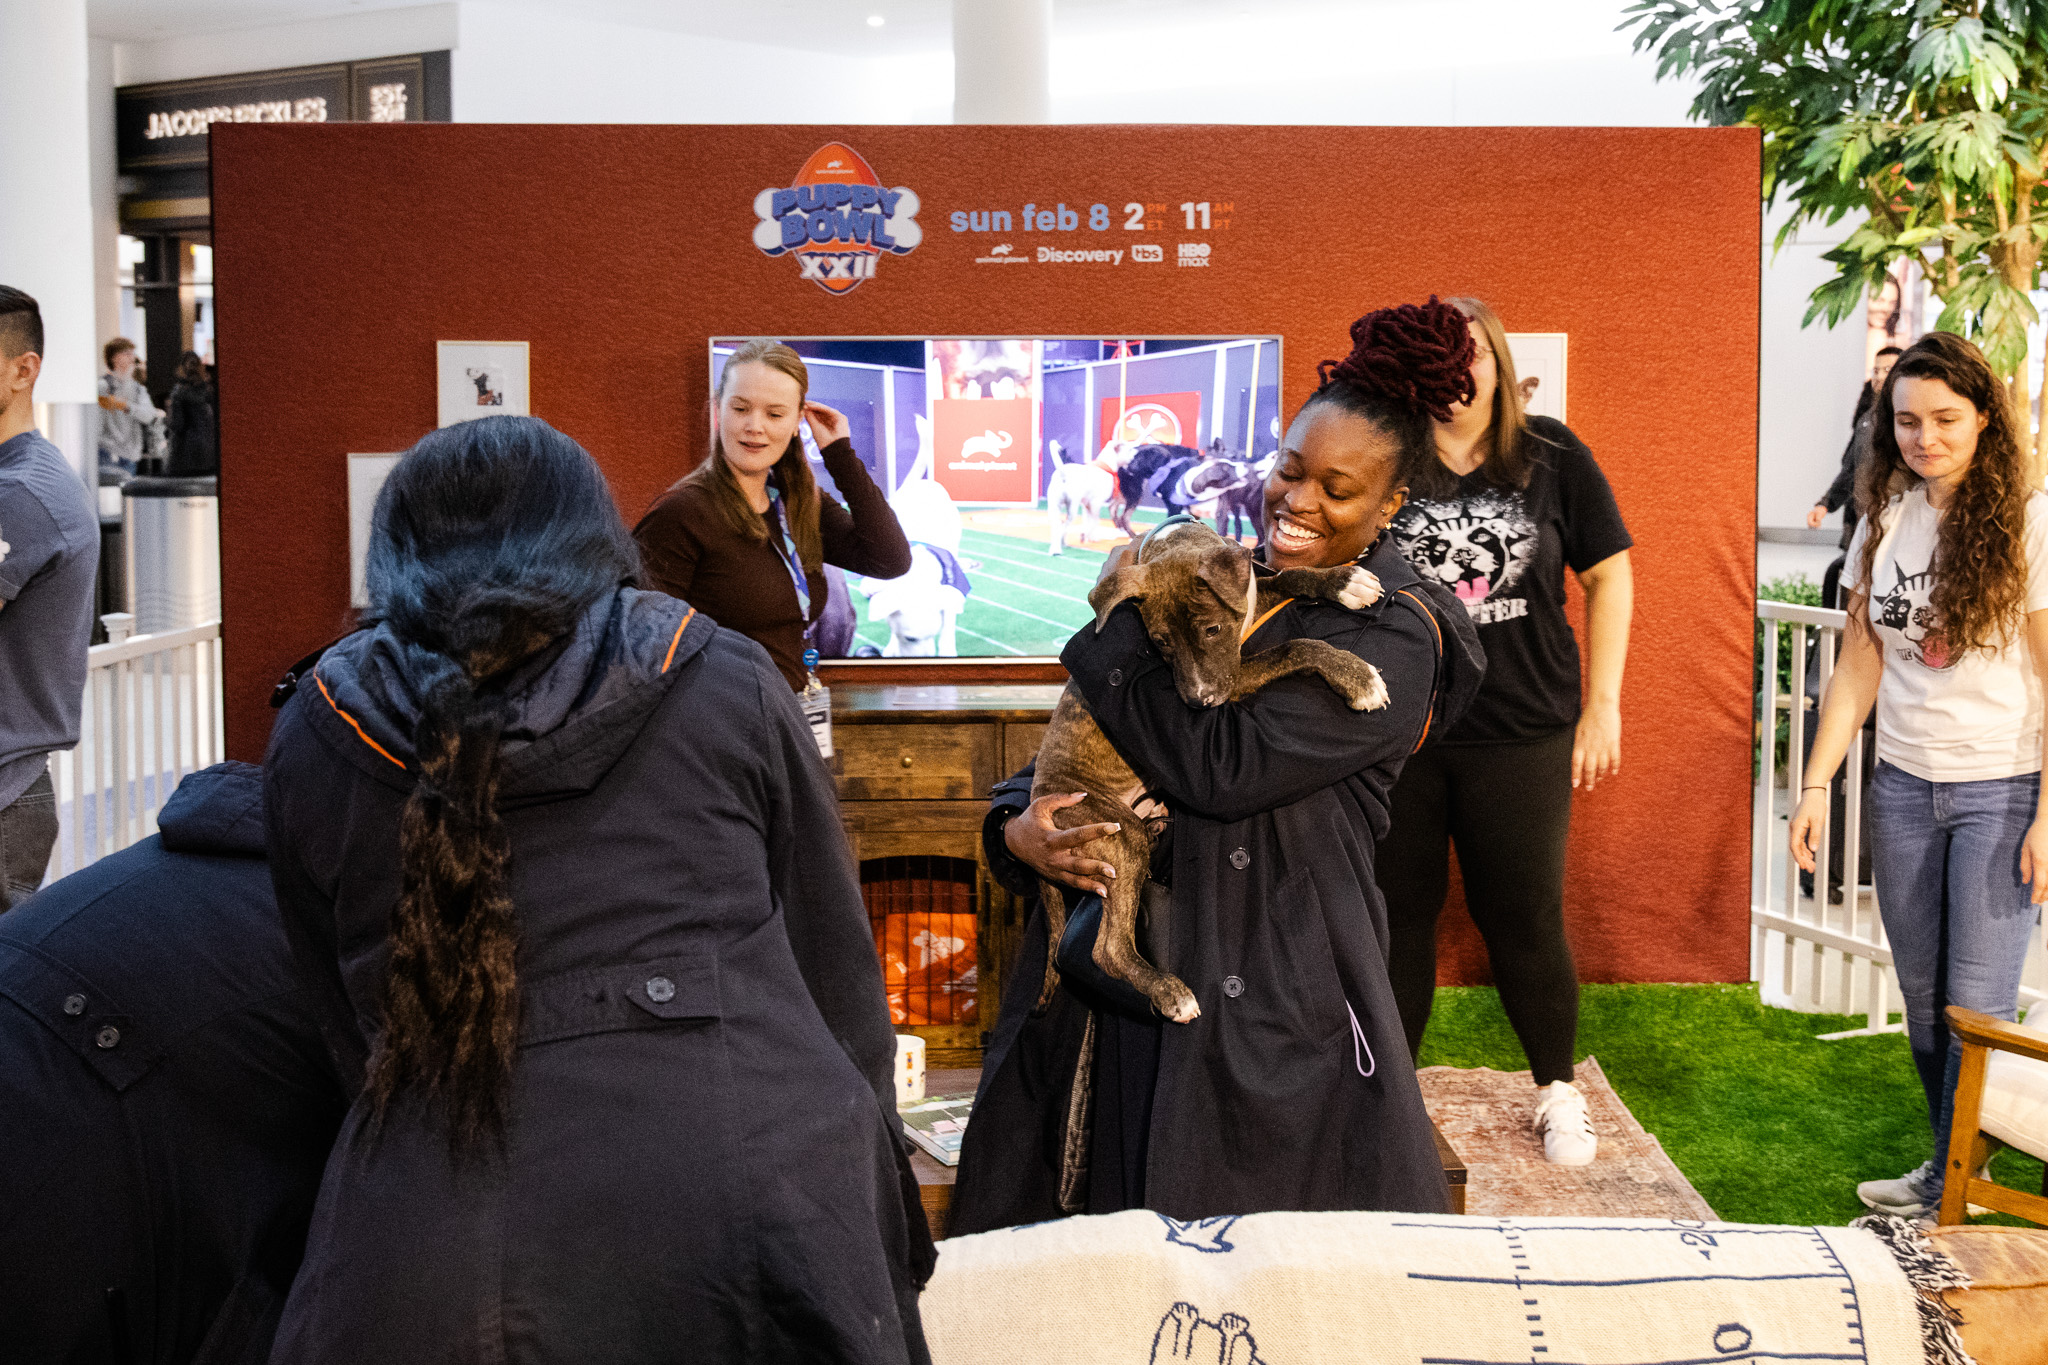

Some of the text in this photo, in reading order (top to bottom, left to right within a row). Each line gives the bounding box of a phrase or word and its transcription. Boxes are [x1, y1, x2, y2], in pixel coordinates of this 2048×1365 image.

[772, 183, 902, 220] PUPPY
[950, 202, 1235, 232] sun feb 8 2 PM 11 AM
[1147, 220, 1230, 230] ET PT
[780, 210, 896, 249] BOWL
[1036, 246, 1124, 266] Discovery
[1134, 247, 1161, 260] tbs
[1178, 243, 1211, 257] HBO
[800, 254, 877, 279] XXII
[1178, 258, 1210, 267] max
